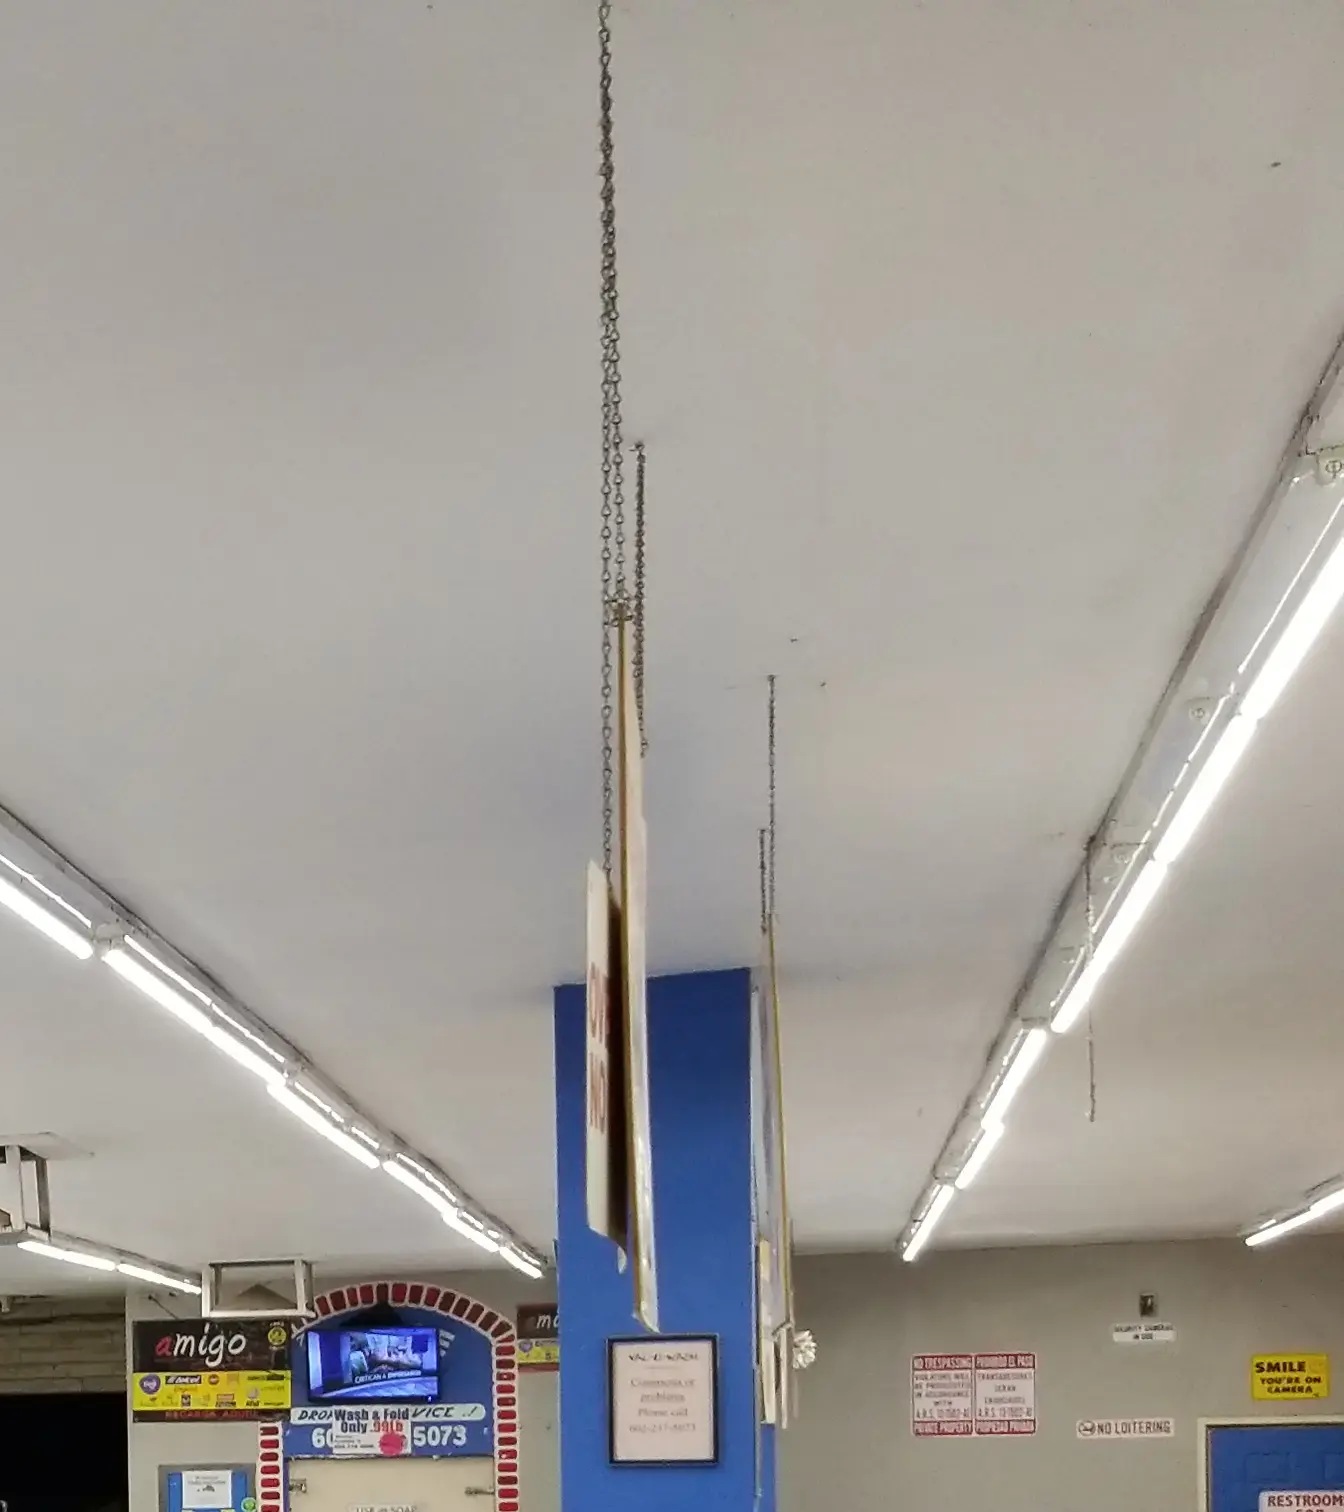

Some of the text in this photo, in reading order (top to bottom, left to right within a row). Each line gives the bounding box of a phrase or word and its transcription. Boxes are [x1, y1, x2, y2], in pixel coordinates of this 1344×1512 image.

[155, 1322, 246, 1367] amigo
[1255, 1361, 1306, 1373] SMILE
[1260, 1376, 1322, 1385] YOU'RE ON
[333, 1408, 369, 1421] Wash
[384, 1408, 410, 1420] Fold
[341, 1421, 368, 1435] Only
[1097, 1420, 1171, 1435] NO LOITERING
[414, 1425, 467, 1447] 5073
